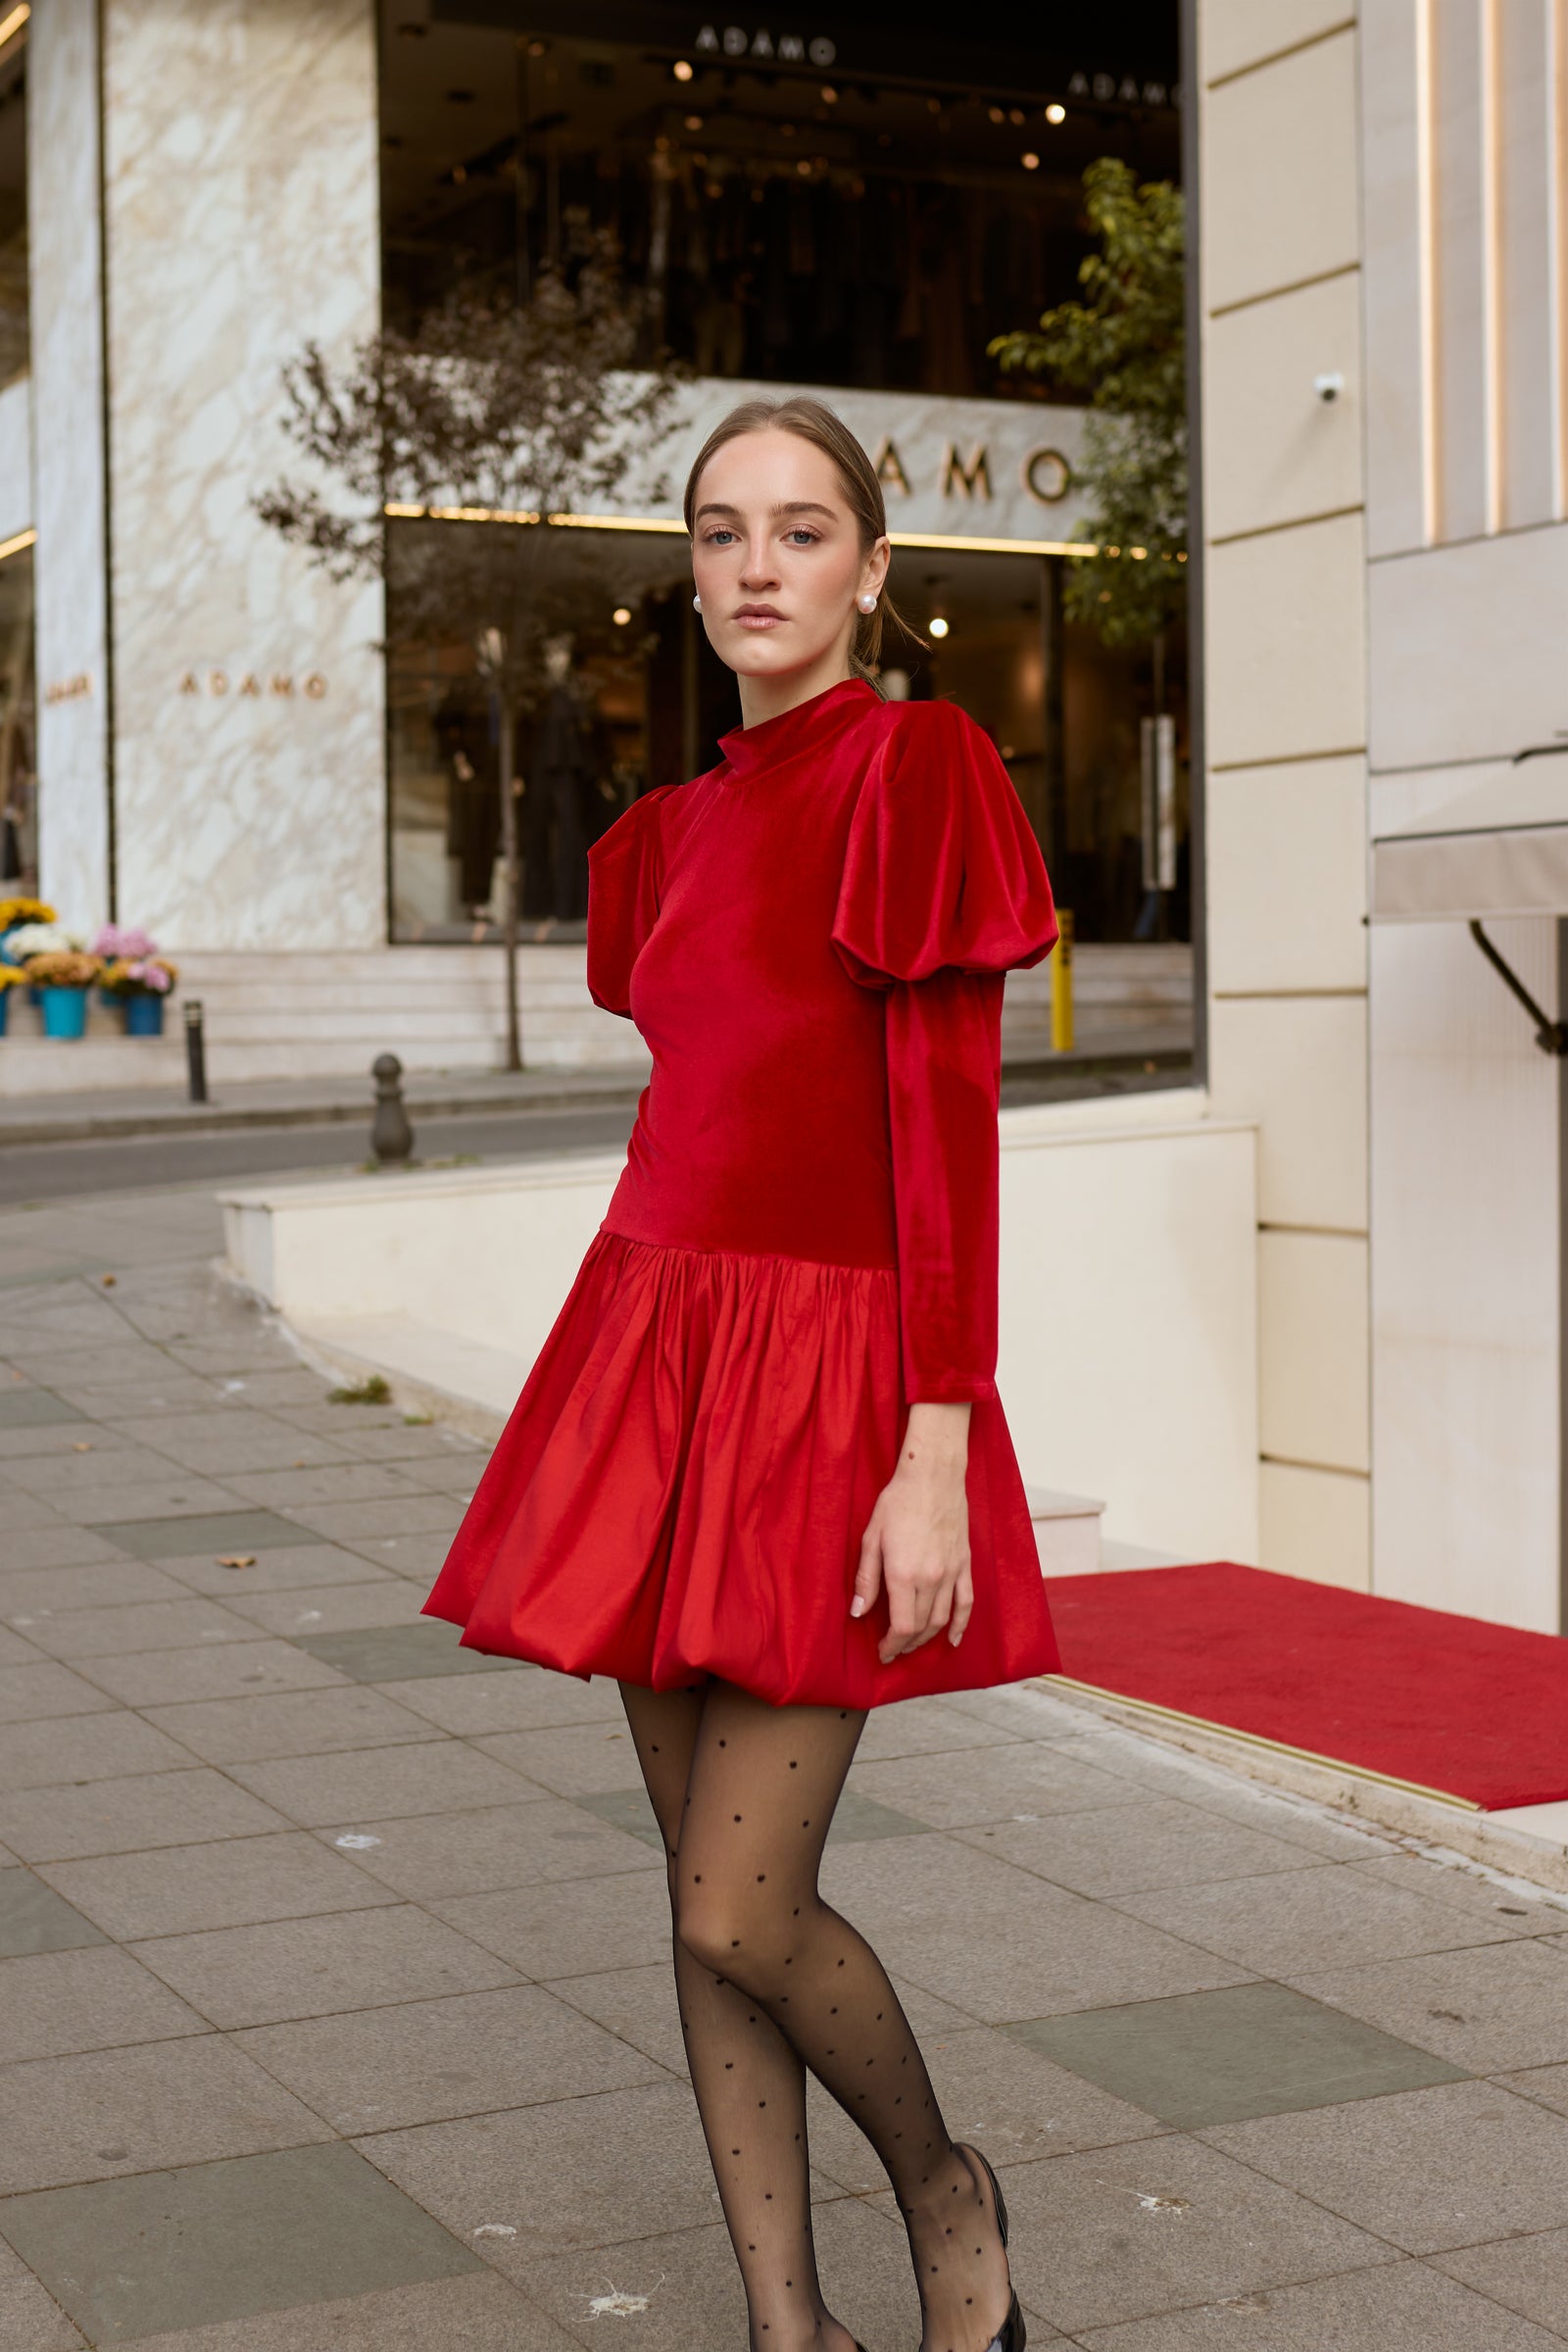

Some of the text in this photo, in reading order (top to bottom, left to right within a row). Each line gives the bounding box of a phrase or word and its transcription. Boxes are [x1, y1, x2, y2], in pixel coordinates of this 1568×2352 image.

[695, 24, 836, 67] ADAMO
[875, 434, 1072, 506] AMO
[179, 669, 328, 700] ADAMO
